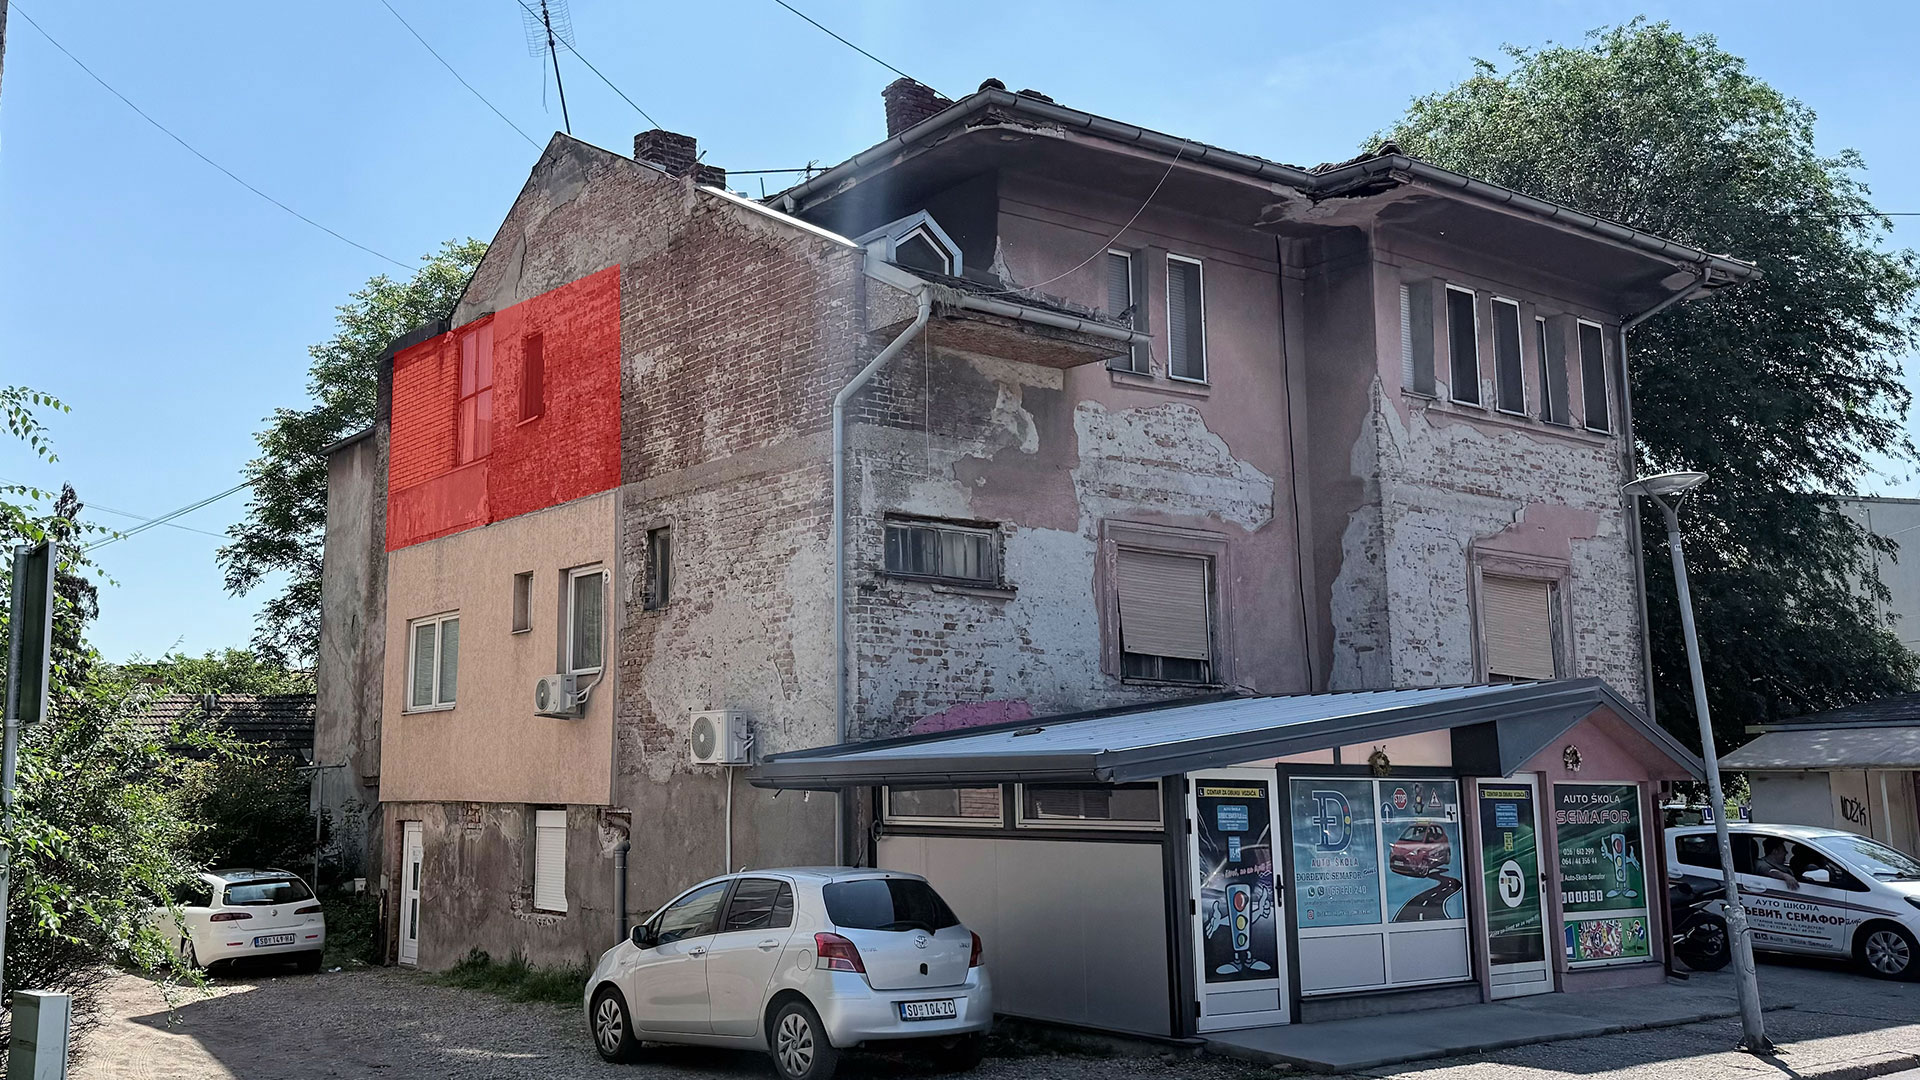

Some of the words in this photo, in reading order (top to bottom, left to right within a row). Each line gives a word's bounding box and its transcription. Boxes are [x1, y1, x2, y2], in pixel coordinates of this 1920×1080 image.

[1395, 794, 1406, 803] STOP
[1563, 794, 1588, 803] AUTO
[1591, 793, 1620, 803] ŠKOLA
[1555, 809, 1631, 825] SEMAFOR
[1704, 809, 1711, 820] L
[1740, 808, 1747, 819] L
[1311, 859, 1331, 867] AUTO
[1335, 857, 1359, 867] ŠKOLA
[1331, 871, 1362, 880] SEMAFOR
[1755, 899, 1780, 907] АУТО
[1783, 902, 1820, 912] ШКОЛА
[1785, 911, 1845, 926] СЕМАФОР
[907, 1004, 919, 1017] SD
